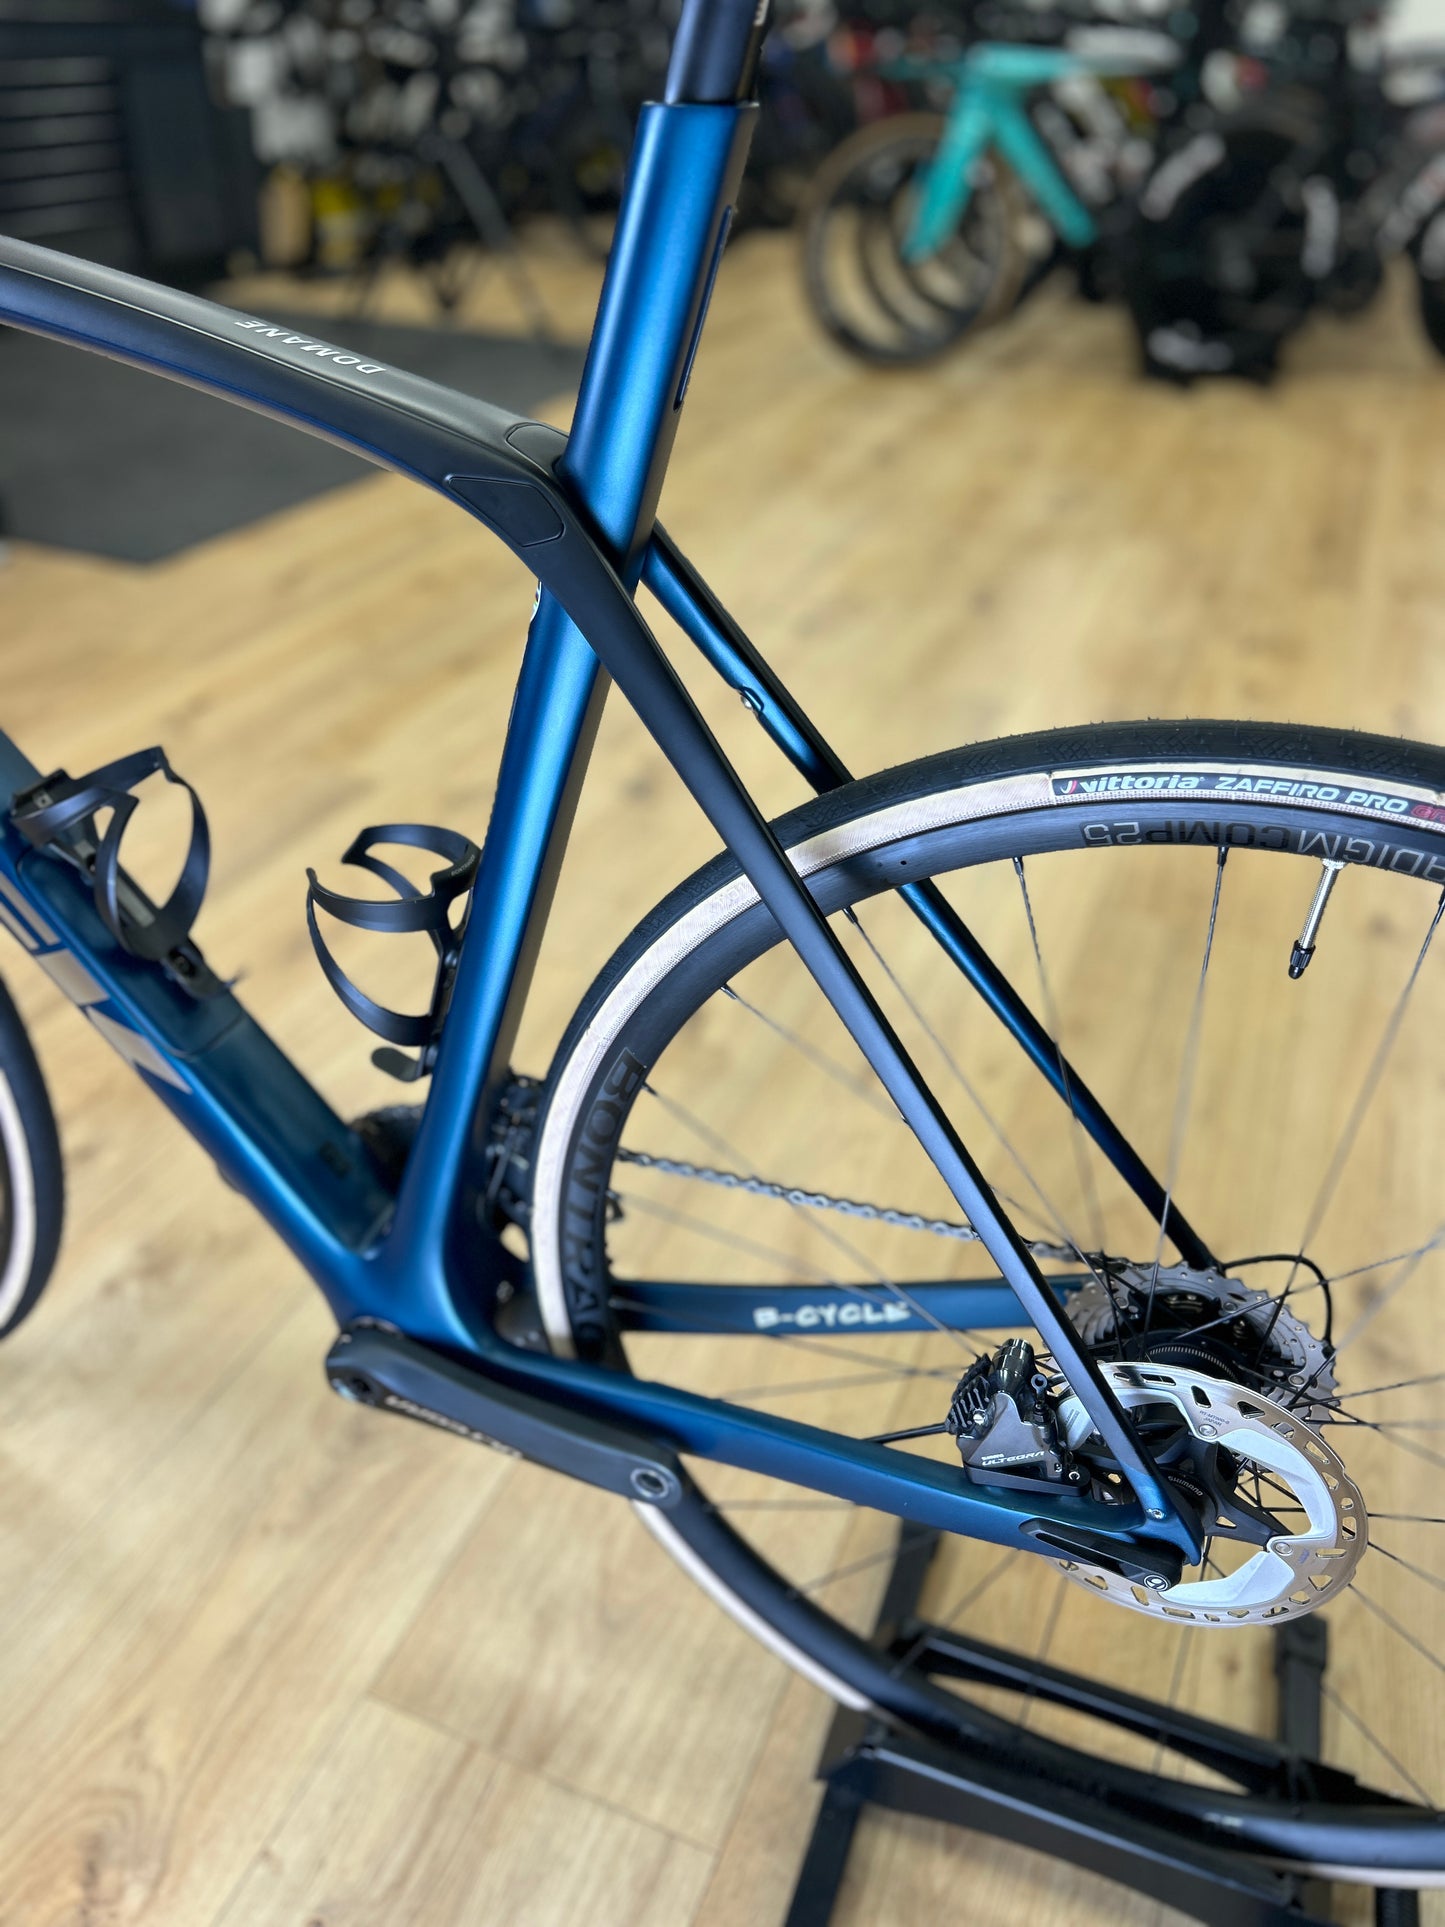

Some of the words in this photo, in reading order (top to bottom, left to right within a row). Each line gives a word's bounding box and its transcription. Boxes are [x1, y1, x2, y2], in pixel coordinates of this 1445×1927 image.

[234, 320, 387, 374] DOMANE
[1079, 774, 1199, 793] vittoria
[1214, 776, 1341, 801] ZAFFIRO
[1344, 790, 1409, 813] PRO
[752, 1301, 912, 1330] B-CYCLE
